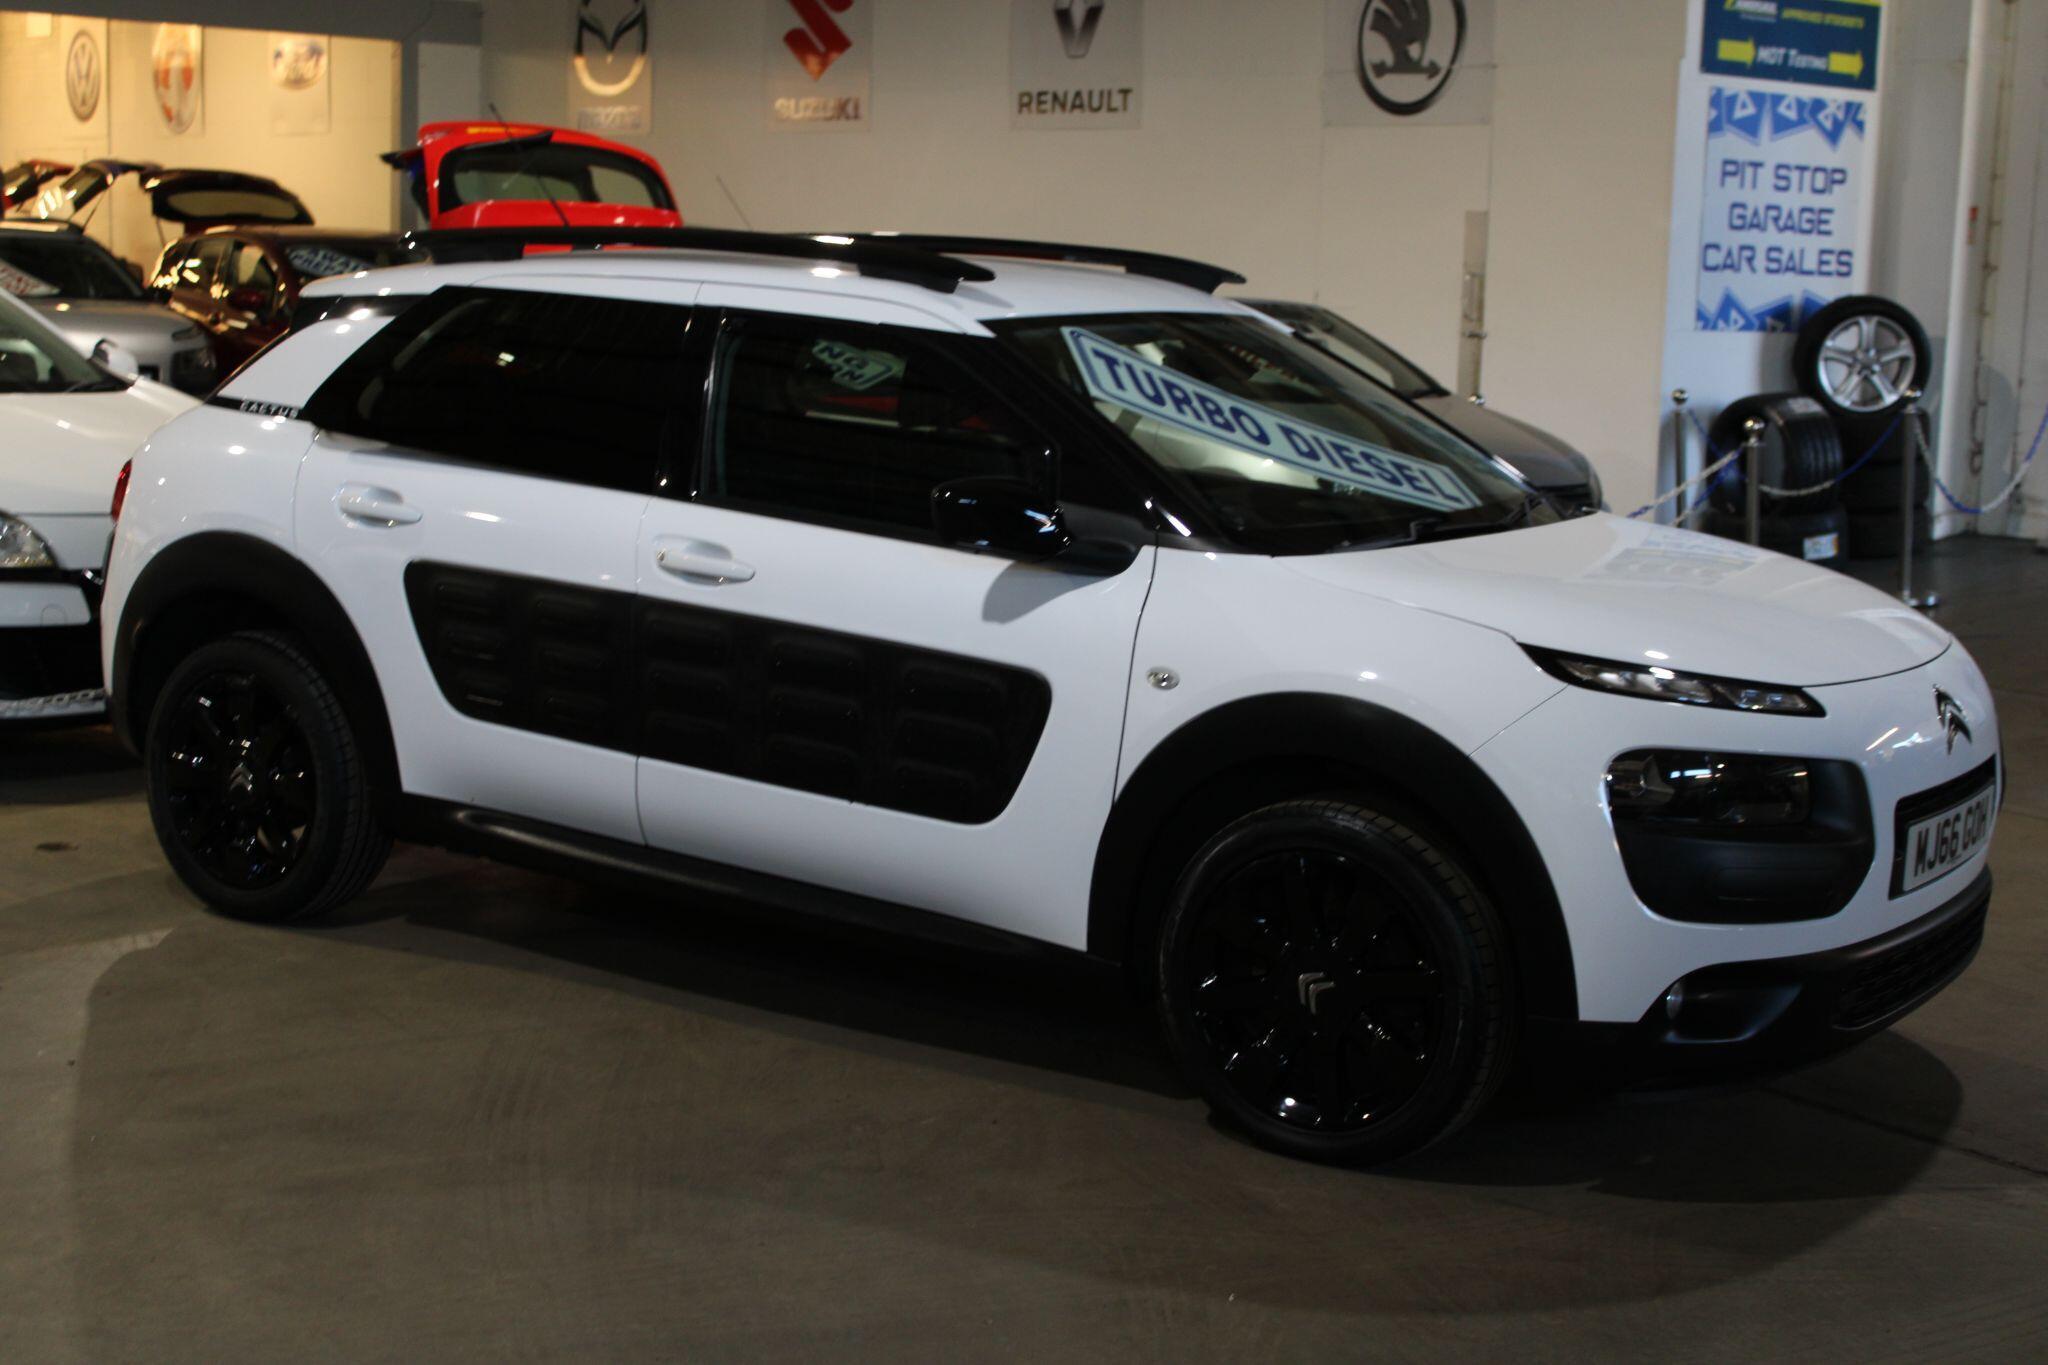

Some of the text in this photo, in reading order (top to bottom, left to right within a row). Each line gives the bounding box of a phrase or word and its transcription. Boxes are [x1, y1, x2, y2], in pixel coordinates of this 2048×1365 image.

[1017, 88, 1134, 114] RENAULT
[1719, 159, 1847, 195] PIT STOP
[1728, 203, 1835, 236] GARAGE
[1702, 243, 1853, 277] CAR SALES
[1093, 348, 1466, 501] TURBO DIESEL
